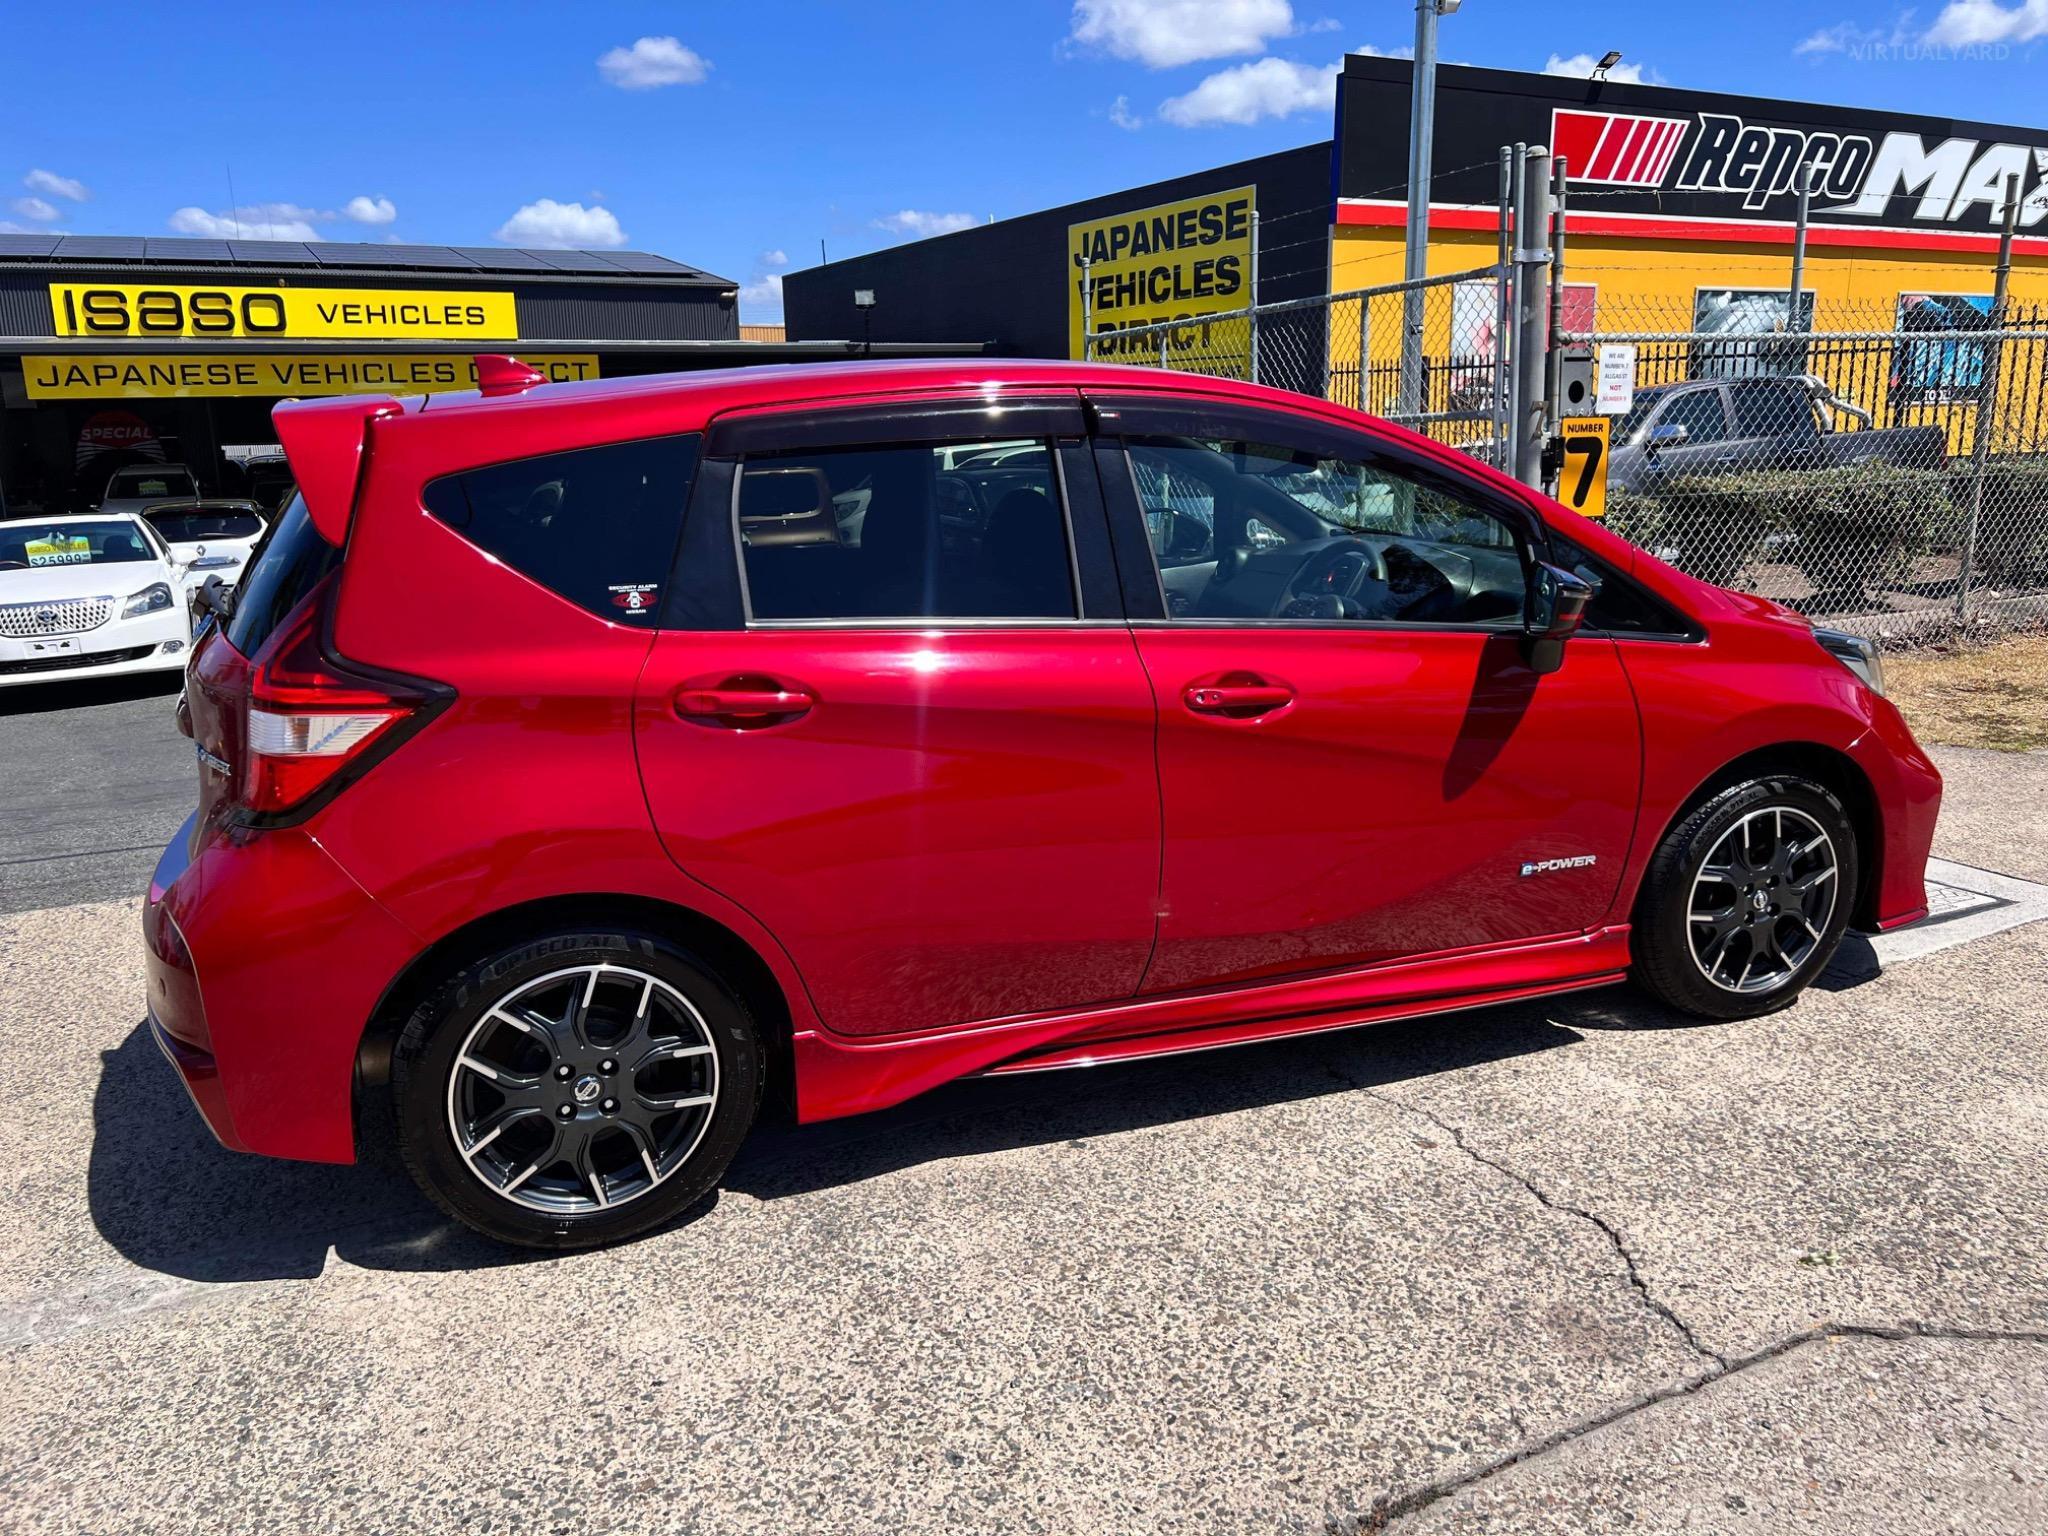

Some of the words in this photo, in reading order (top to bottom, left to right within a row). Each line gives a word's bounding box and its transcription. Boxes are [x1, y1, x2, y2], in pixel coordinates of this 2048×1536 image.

[1074, 199, 1248, 267] JAPANESE
[1078, 255, 1240, 311] VEHICLES
[317, 304, 485, 325] VEHICLES
[37, 364, 258, 388] JAPANESE
[271, 363, 454, 385] VEHICLES
[81, 426, 152, 441] SPECIAL
[1567, 423, 1604, 433] NUMBER
[1566, 436, 1603, 508] 7
[1521, 854, 1597, 876] e-POWER
